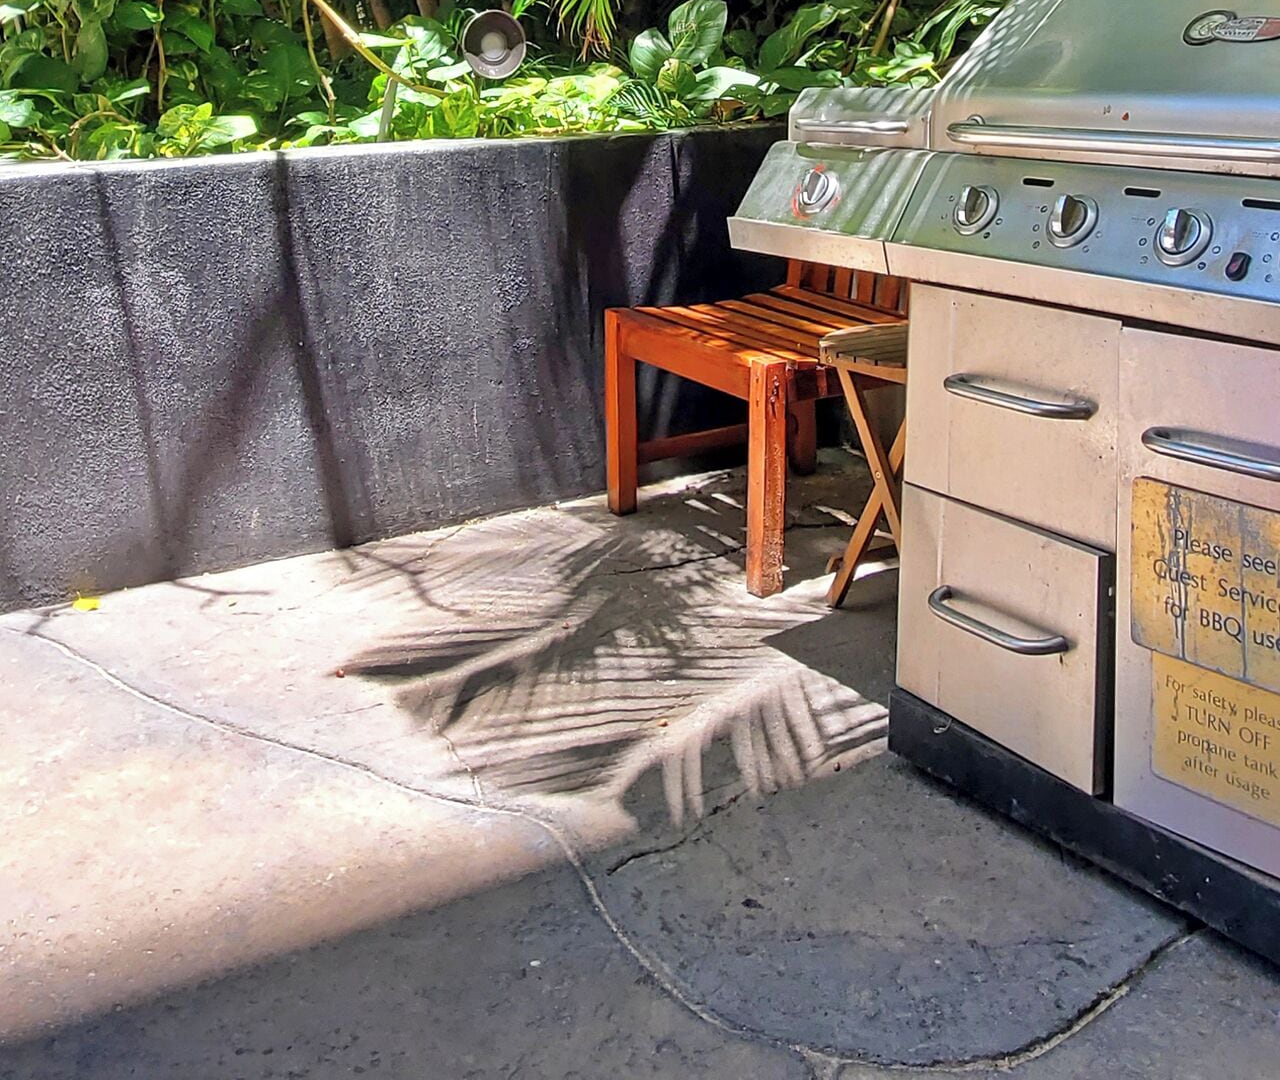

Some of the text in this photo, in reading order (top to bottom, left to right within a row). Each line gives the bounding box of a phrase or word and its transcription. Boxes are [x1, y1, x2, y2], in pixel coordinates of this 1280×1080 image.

[1153, 558, 1208, 592] Guest
[1174, 529, 1276, 576] Please see
[1164, 595, 1189, 621] for
[1199, 608, 1243, 644] BBQ
[1165, 675, 1186, 694] For
[1184, 704, 1272, 750] TURN OFF
[1177, 729, 1279, 780] propane tank
[1184, 755, 1271, 800] after usage
